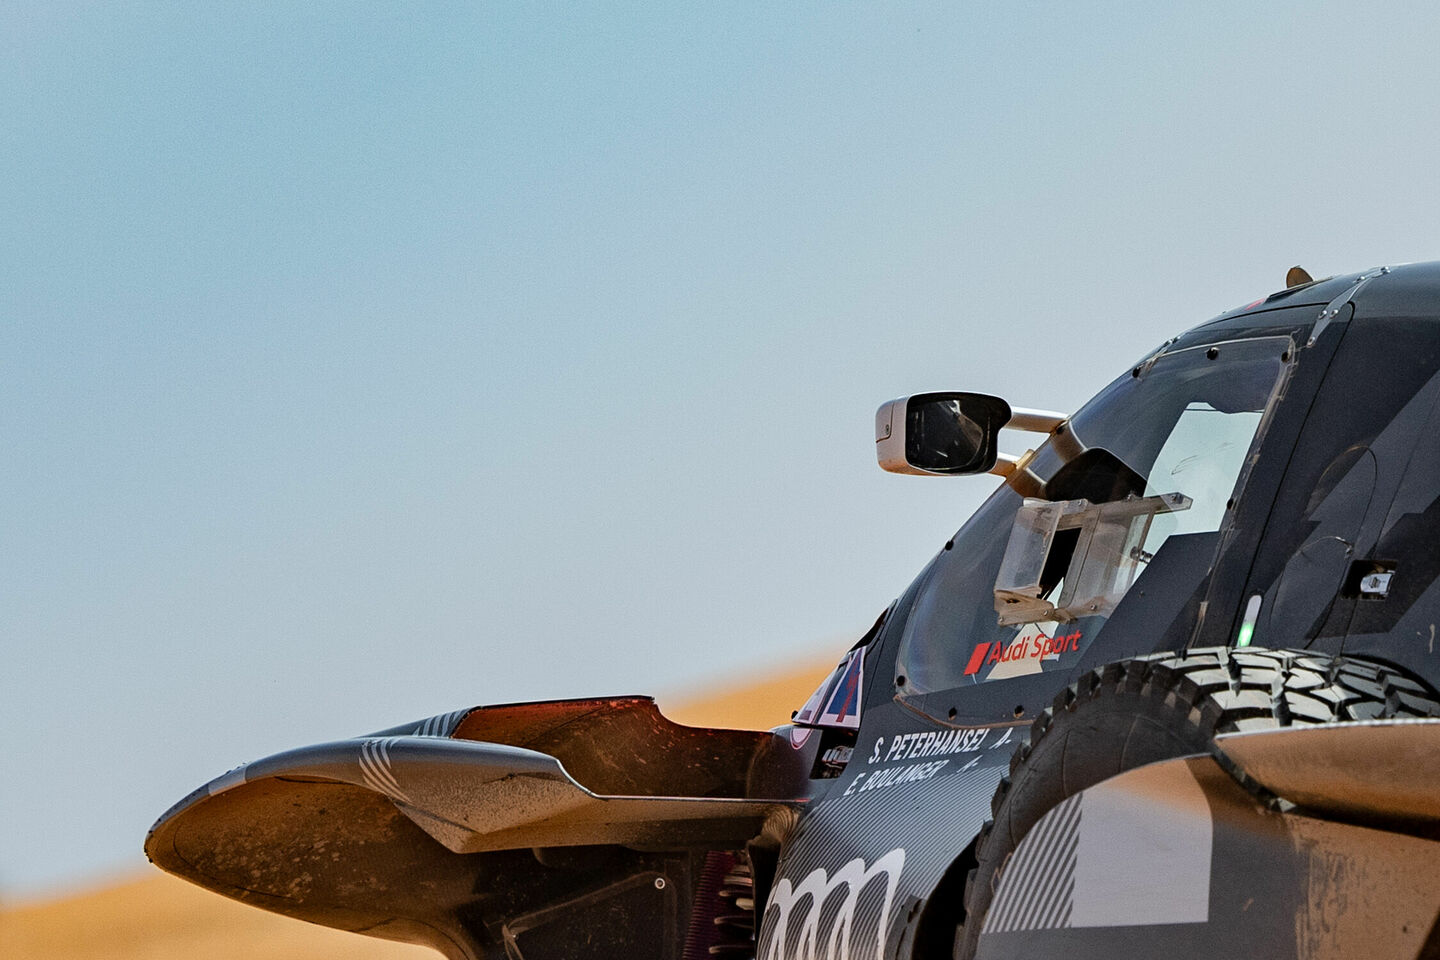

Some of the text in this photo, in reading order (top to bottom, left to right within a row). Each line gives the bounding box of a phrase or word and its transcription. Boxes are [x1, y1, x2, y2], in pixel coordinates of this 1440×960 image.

[987, 629, 1082, 665] Audi Sport
[868, 736, 884, 765] S.
[884, 728, 990, 762] PETERHANSEL
[858, 759, 950, 793] BOULANGER
